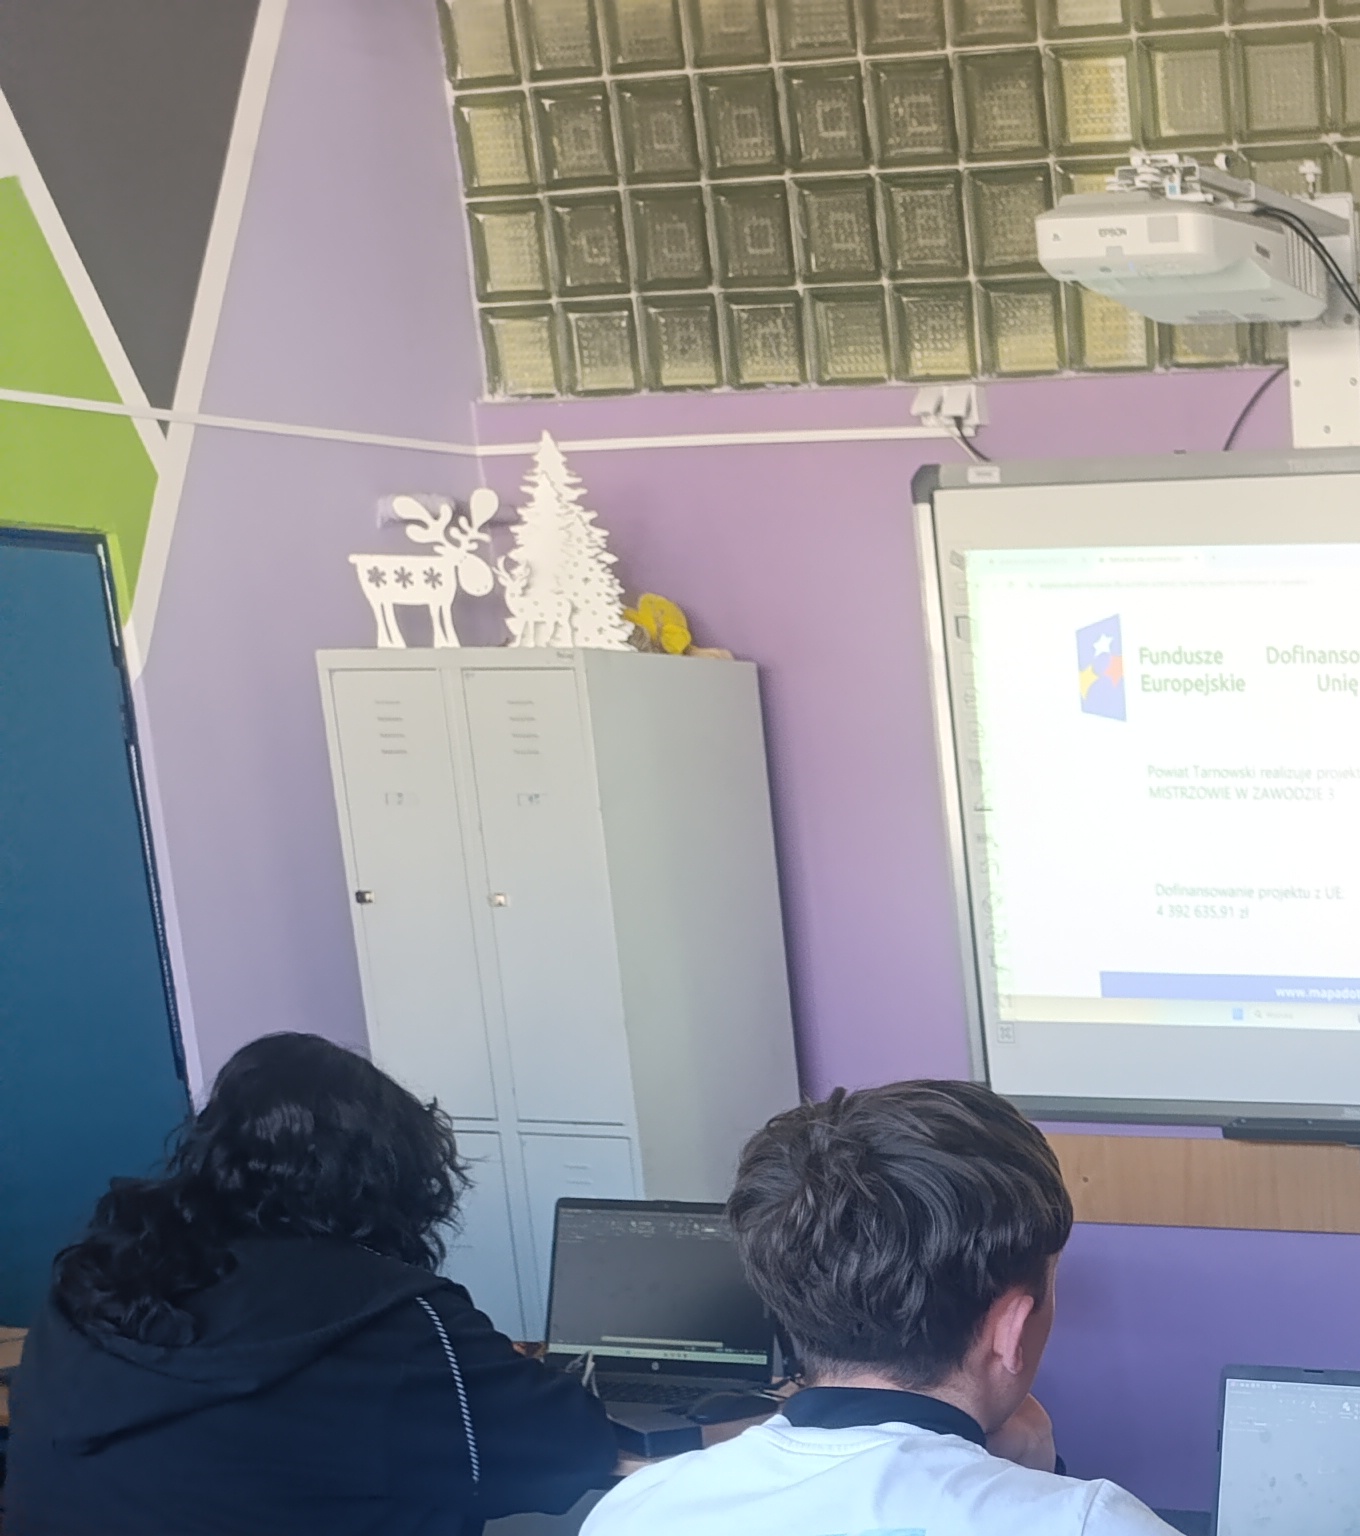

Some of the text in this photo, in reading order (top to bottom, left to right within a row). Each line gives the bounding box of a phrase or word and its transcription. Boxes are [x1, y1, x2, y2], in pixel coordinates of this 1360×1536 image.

[1138, 646, 1224, 666] Fundusze
[1140, 673, 1247, 696] Europejskie
[1316, 673, 1359, 697] Unię
[1147, 765, 1190, 780] Powiat
[1193, 765, 1257, 780] Tarnowski
[1260, 765, 1313, 784] realizuje
[1148, 785, 1233, 801] MISTRZOWIE
[1234, 786, 1249, 800] W
[1253, 786, 1324, 801] ZAWODZIE
[1154, 883, 1256, 900] Dofinansowanie
[1258, 885, 1311, 903] projektu
[1315, 888, 1322, 900] z
